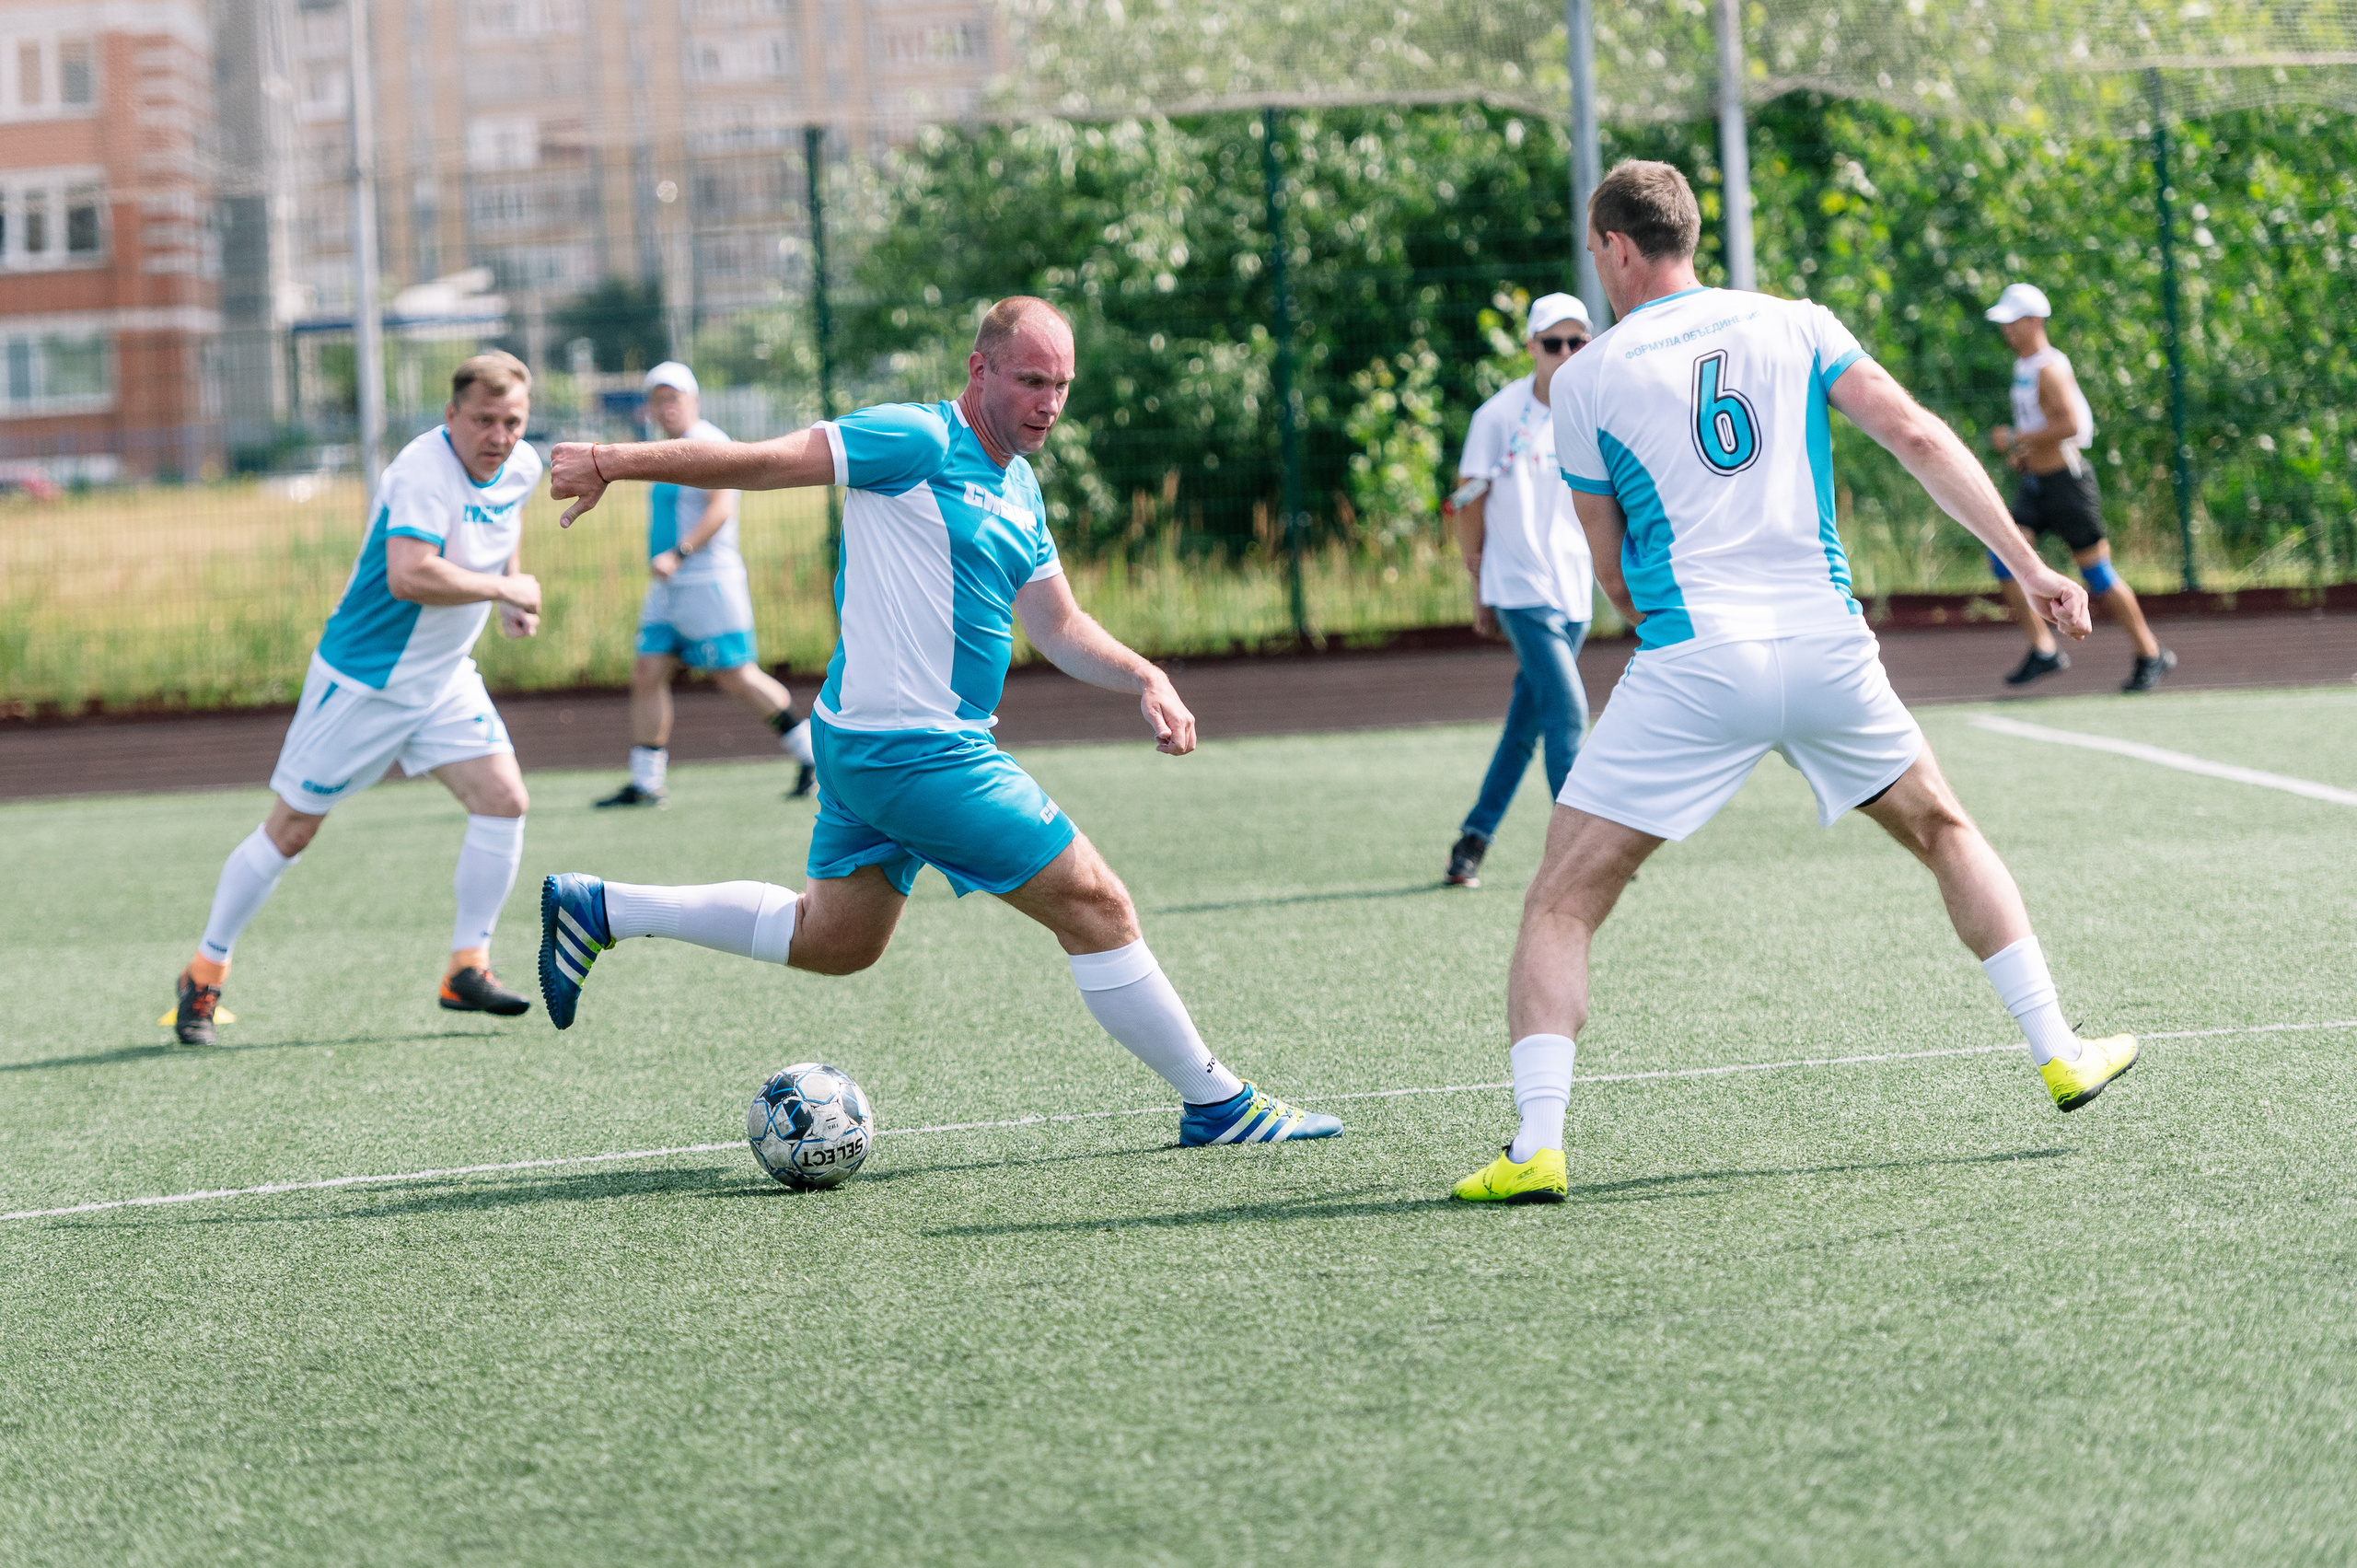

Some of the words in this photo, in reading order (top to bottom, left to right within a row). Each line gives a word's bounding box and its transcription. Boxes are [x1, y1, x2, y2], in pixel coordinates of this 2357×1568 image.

[1625, 335, 1681, 360] ФОРМУЛА
[1689, 348, 1762, 477] 6
[802, 1137, 864, 1167] SELECT
